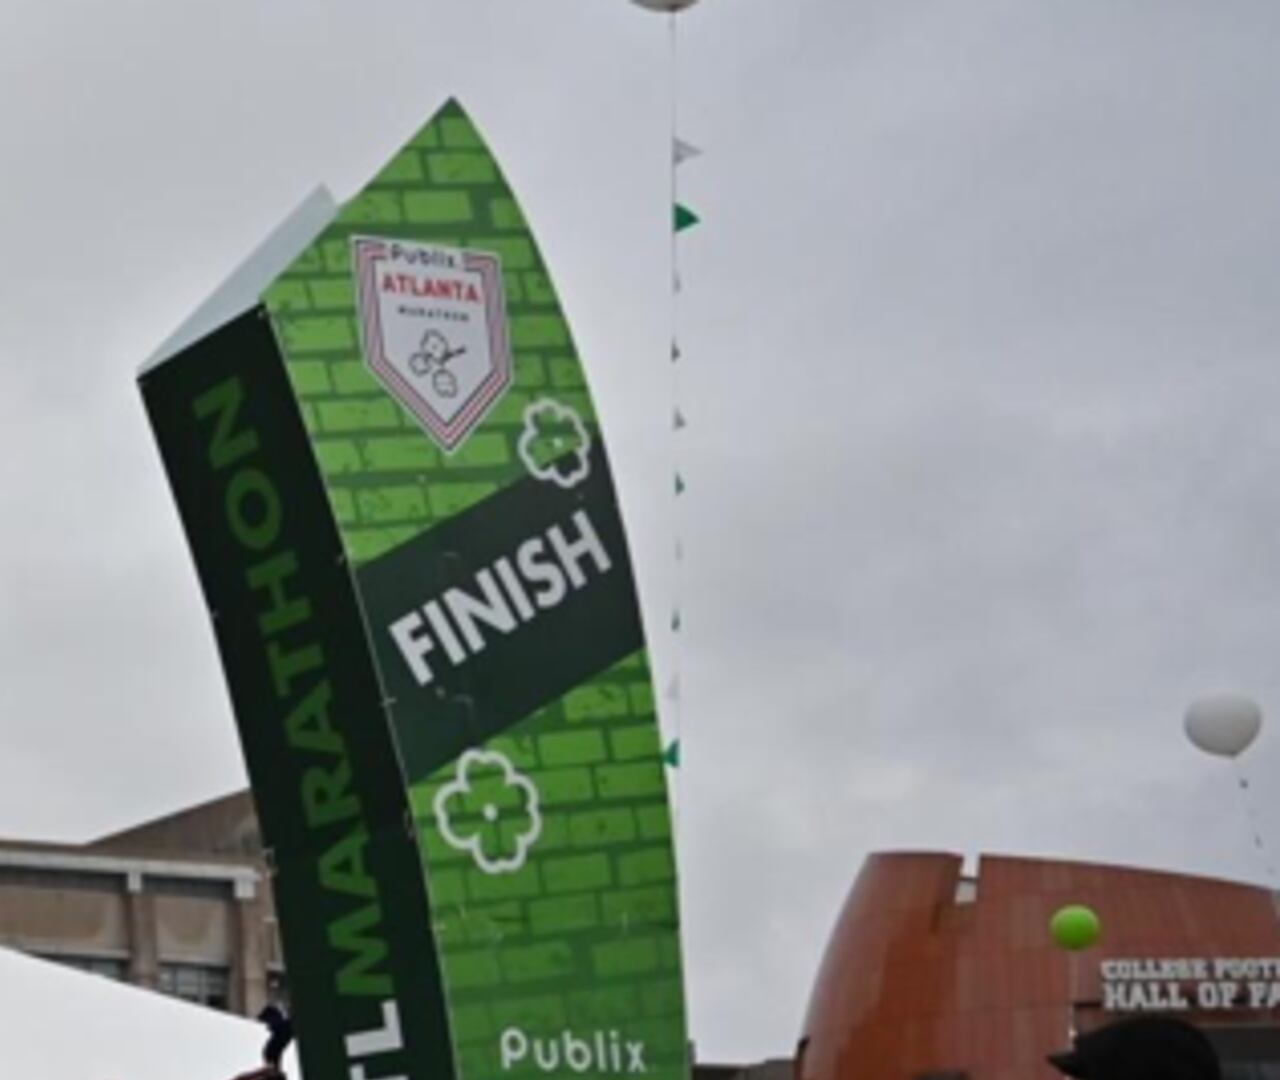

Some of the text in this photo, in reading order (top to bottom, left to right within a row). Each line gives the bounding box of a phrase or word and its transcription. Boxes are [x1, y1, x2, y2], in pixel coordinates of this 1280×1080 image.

[382, 273, 478, 303] ATLANTA
[387, 509, 612, 688] FINISH
[1100, 957, 1280, 979] COLLEGE FOOT
[1103, 981, 1189, 1009] HALL
[1197, 981, 1237, 1009] OF
[499, 1026, 646, 1073] Publix
